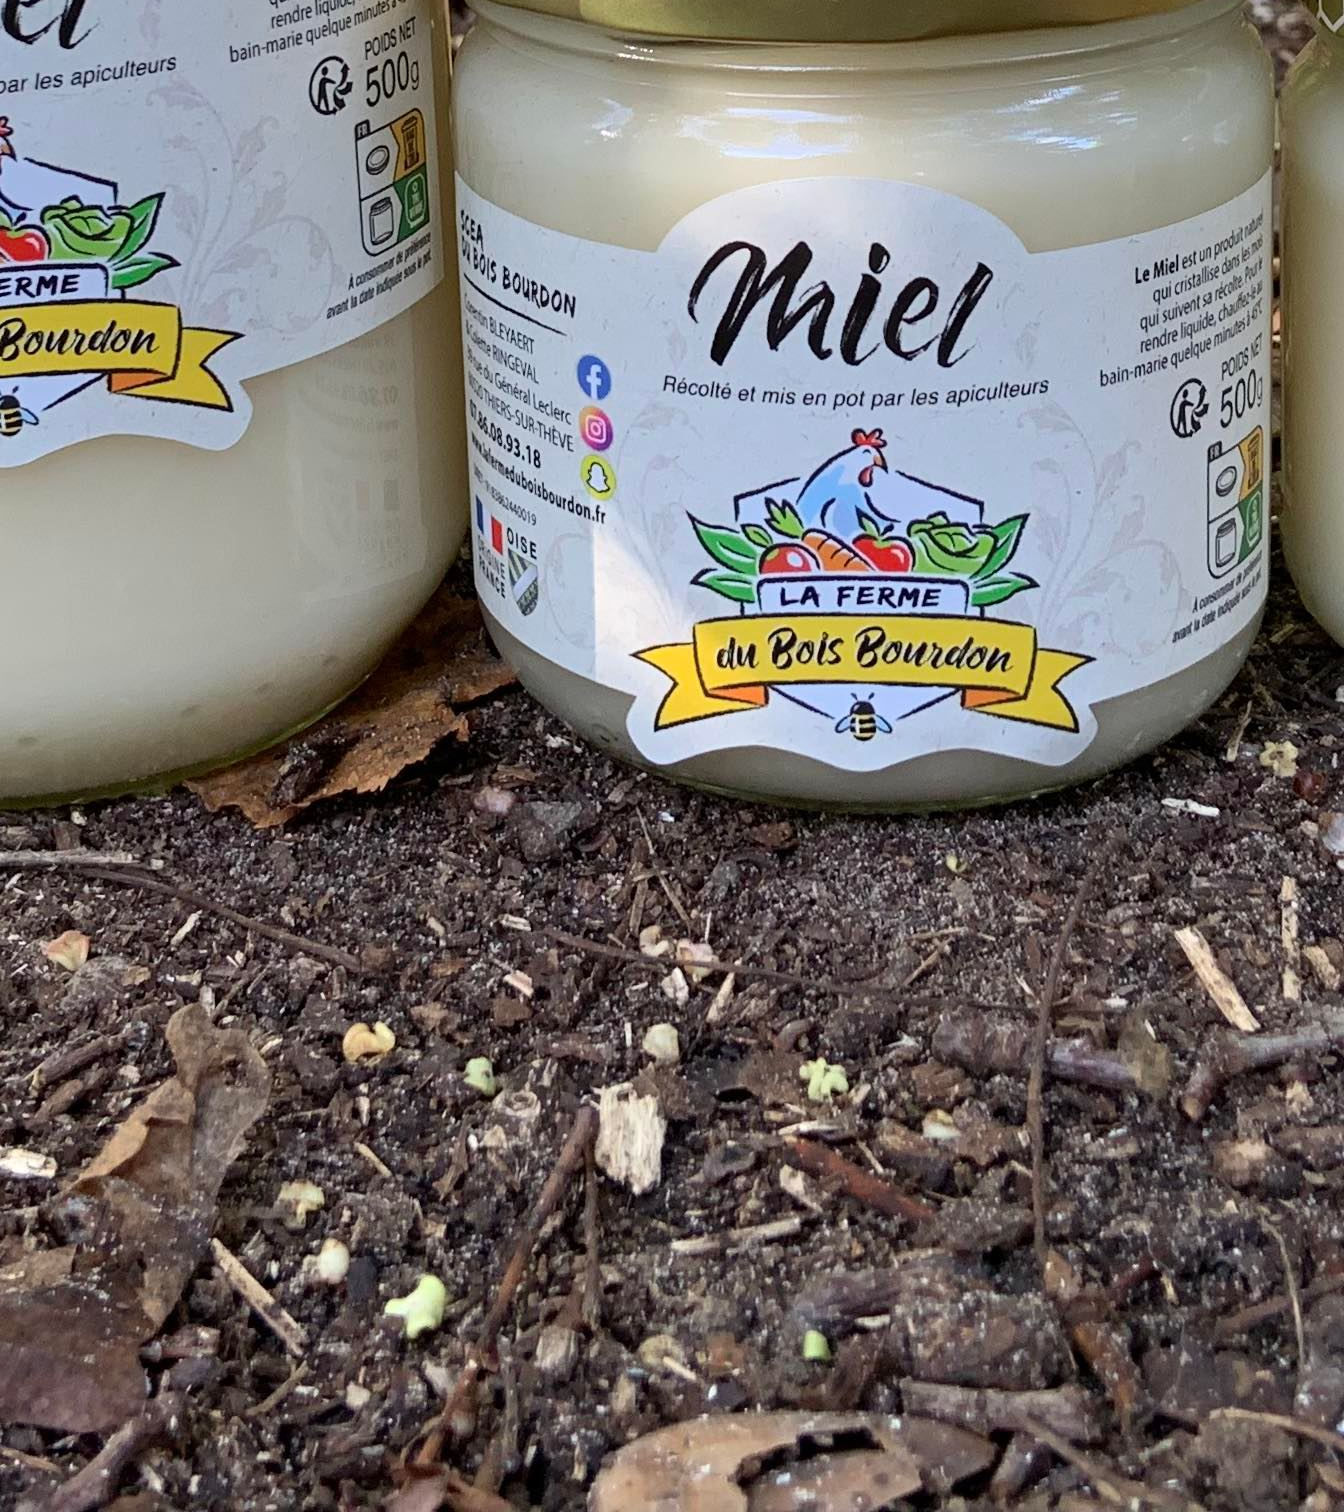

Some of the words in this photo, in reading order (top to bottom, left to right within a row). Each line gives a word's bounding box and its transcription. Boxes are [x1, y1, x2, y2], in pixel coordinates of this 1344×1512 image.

[230, 30, 303, 63] bain-marie
[306, 14, 353, 47] quelque
[271, 4, 313, 29] rendre
[365, 28, 397, 60] POIDS
[399, 16, 416, 43] NET
[34, 71, 64, 91] les
[69, 54, 178, 90] apiculteurs
[366, 51, 420, 107] 500g
[460, 209, 484, 250] SCEA
[1134, 267, 1150, 285] Le
[1153, 253, 1179, 279] Miel
[1182, 251, 1197, 269] est
[1199, 246, 1212, 263] un
[1214, 227, 1243, 260] produit
[1153, 282, 1172, 305] qui
[1174, 265, 1220, 296] cristallise
[1222, 256, 1241, 275] dans
[1241, 246, 1251, 265] les
[473, 247, 497, 284] BOIS
[502, 265, 577, 318] BOURDON
[687, 240, 994, 368] Miel
[1140, 311, 1160, 333] qui
[1163, 295, 1200, 324] suivent
[1202, 293, 1213, 308] sa
[1215, 273, 1244, 305] récolte.
[489, 317, 536, 355] BLEYAERT
[1100, 354, 1168, 387] bain-marie
[1170, 338, 1211, 368] quelque
[1213, 317, 1246, 347] minutes
[1140, 330, 1178, 354] rendre
[1180, 312, 1216, 340] liquide,
[1221, 345, 1249, 381] POIDS
[1250, 332, 1263, 359] NET
[492, 346, 540, 384] RINGEVAL
[484, 365, 494, 384] du
[494, 371, 531, 406] Général
[532, 388, 573, 426] Leclerc
[663, 375, 731, 400] Récolté
[738, 386, 756, 403] et
[762, 388, 796, 406] mis
[802, 391, 827, 406] en
[833, 389, 865, 411] pot
[871, 389, 904, 411] par
[910, 387, 939, 406] les
[945, 377, 1049, 407] apiculteurs
[1220, 368, 1263, 429] 500g
[483, 386, 575, 453] THIERS-SUR-THÈVE
[507, 527, 538, 560] OISE
[478, 554, 506, 599] FRANCE
[780, 586, 820, 607] LA
[837, 585, 941, 607] FERME
[716, 637, 758, 670] du
[768, 626, 844, 670] Bois
[854, 626, 1015, 673] Bourdon
